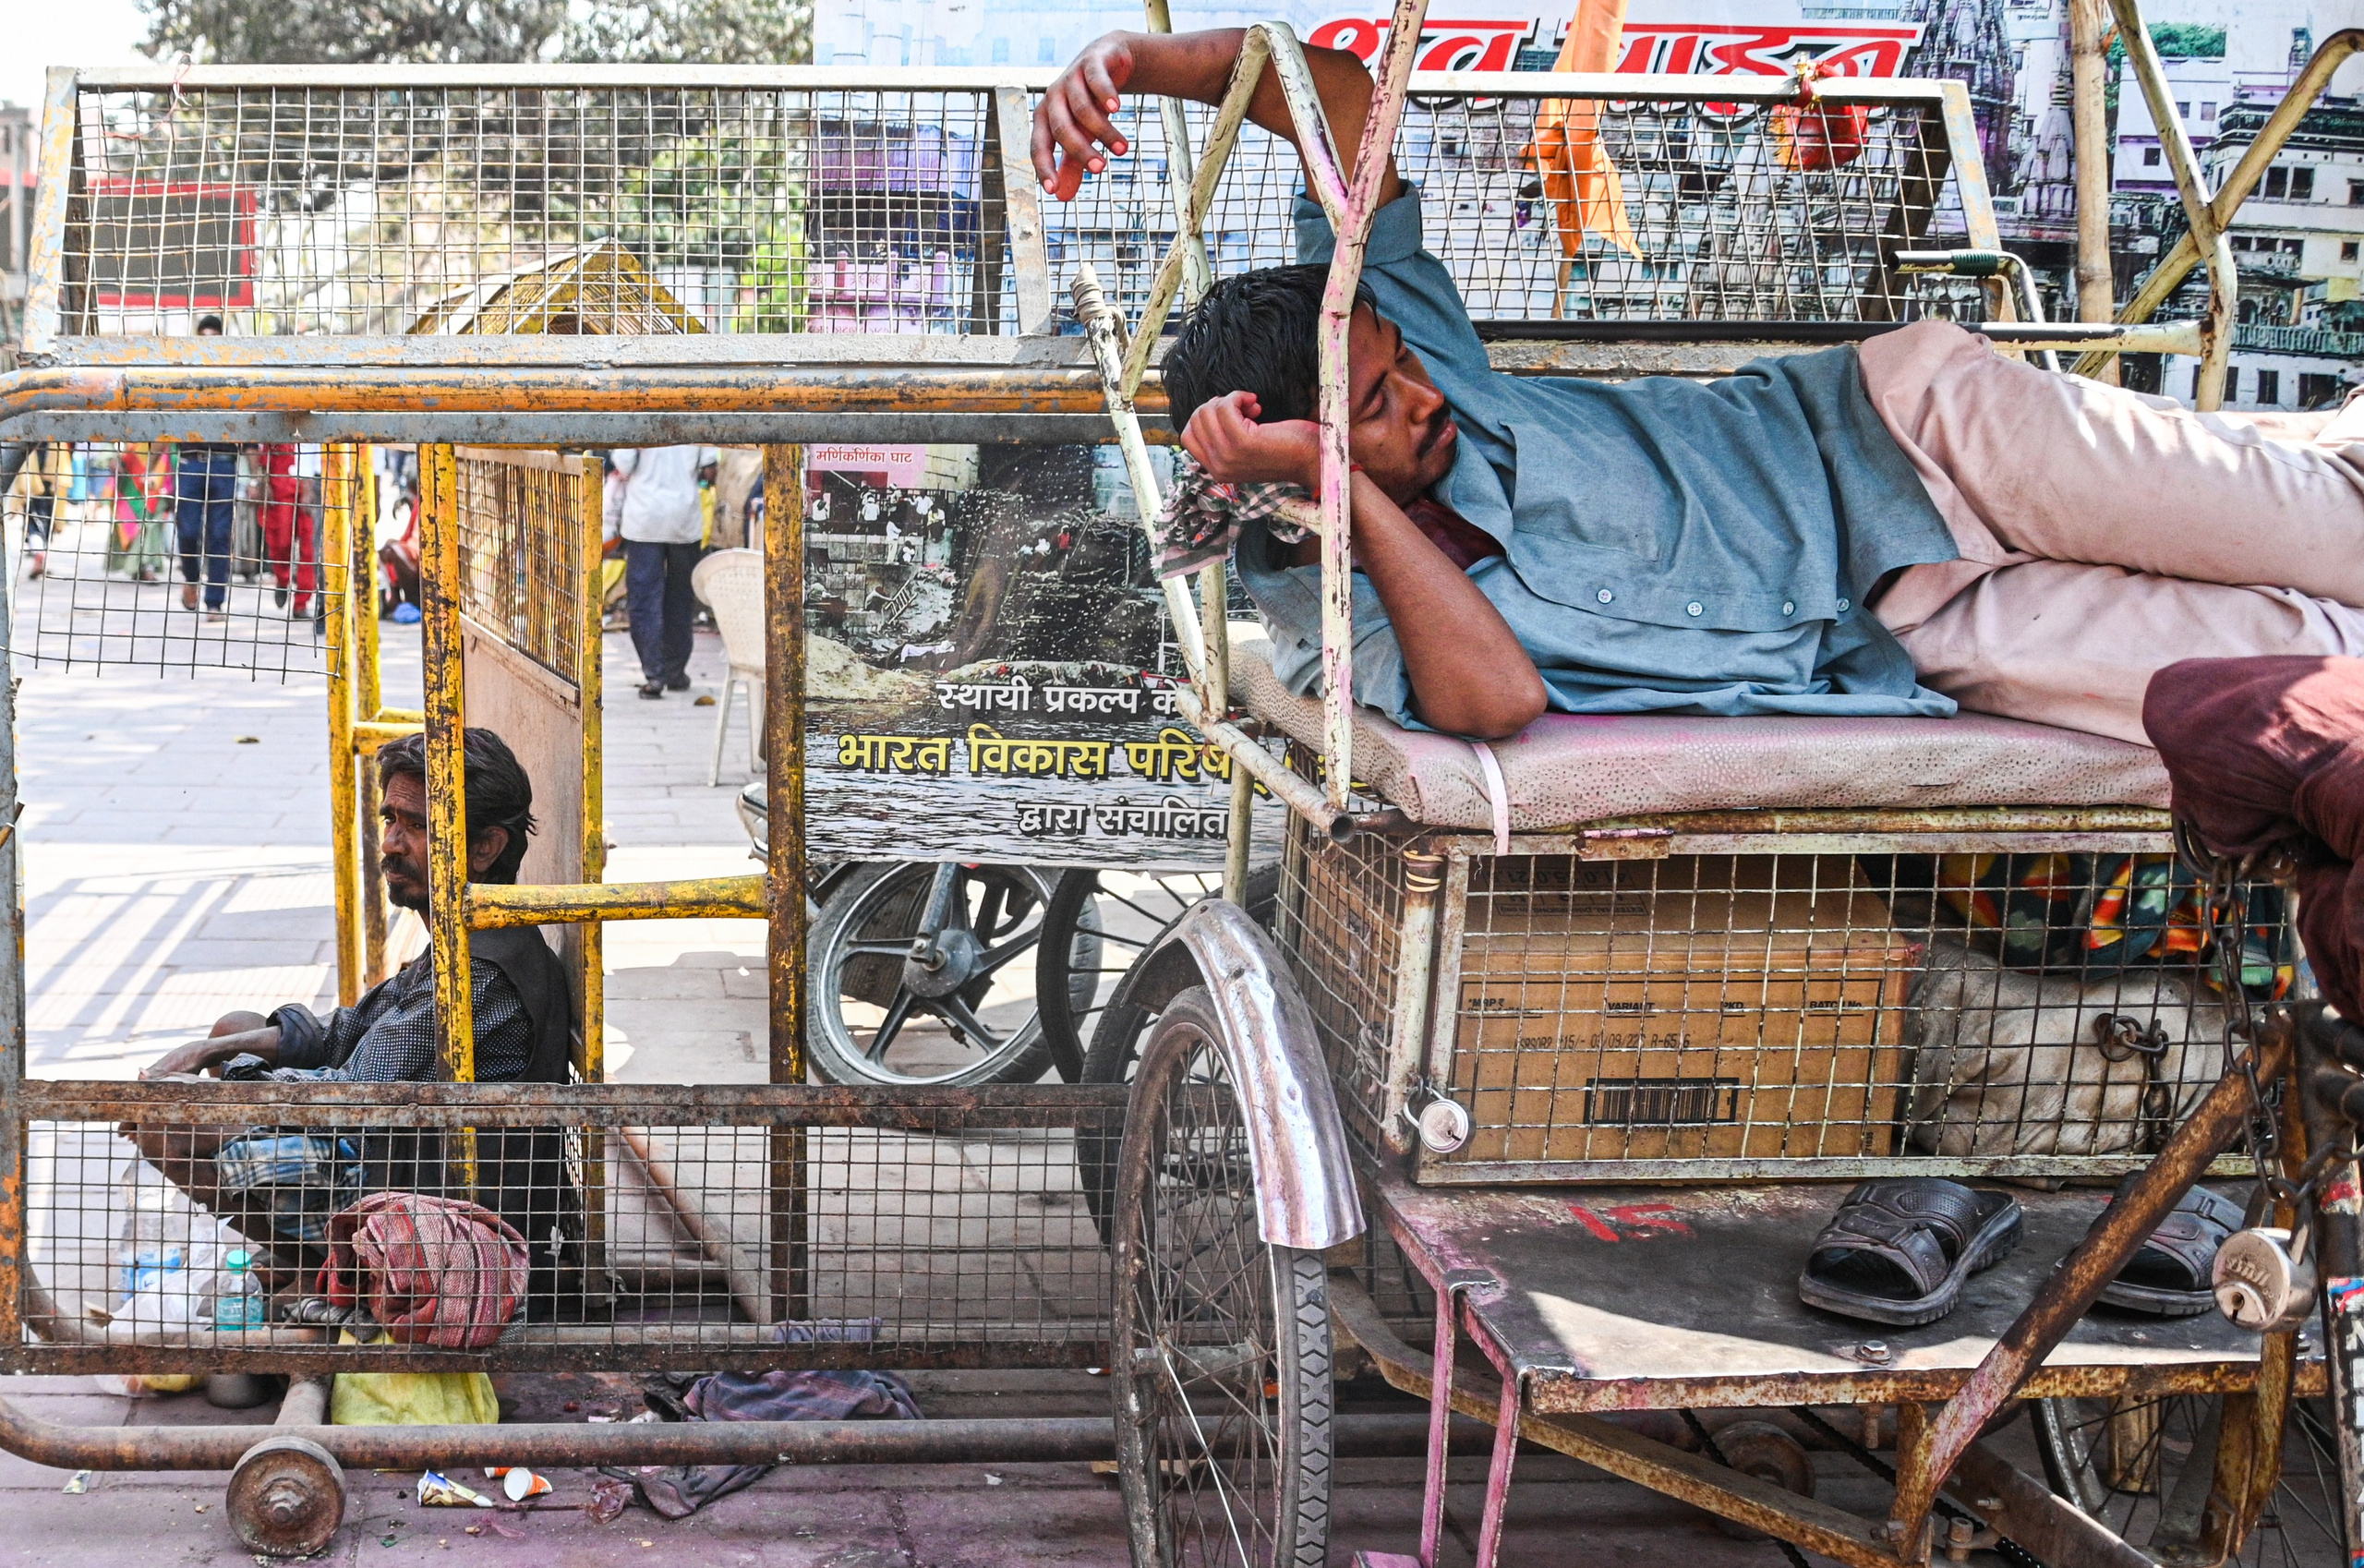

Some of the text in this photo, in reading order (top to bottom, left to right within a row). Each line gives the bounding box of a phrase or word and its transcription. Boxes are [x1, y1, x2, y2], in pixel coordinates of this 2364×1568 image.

[889, 452, 913, 464] घाट
[935, 675, 1033, 711] स्थायी
[1043, 686, 1141, 715] प्रकल्प
[838, 733, 953, 772] भारत
[966, 722, 1111, 776] विकास
[1017, 795, 1228, 834] द्वारा संचालित
